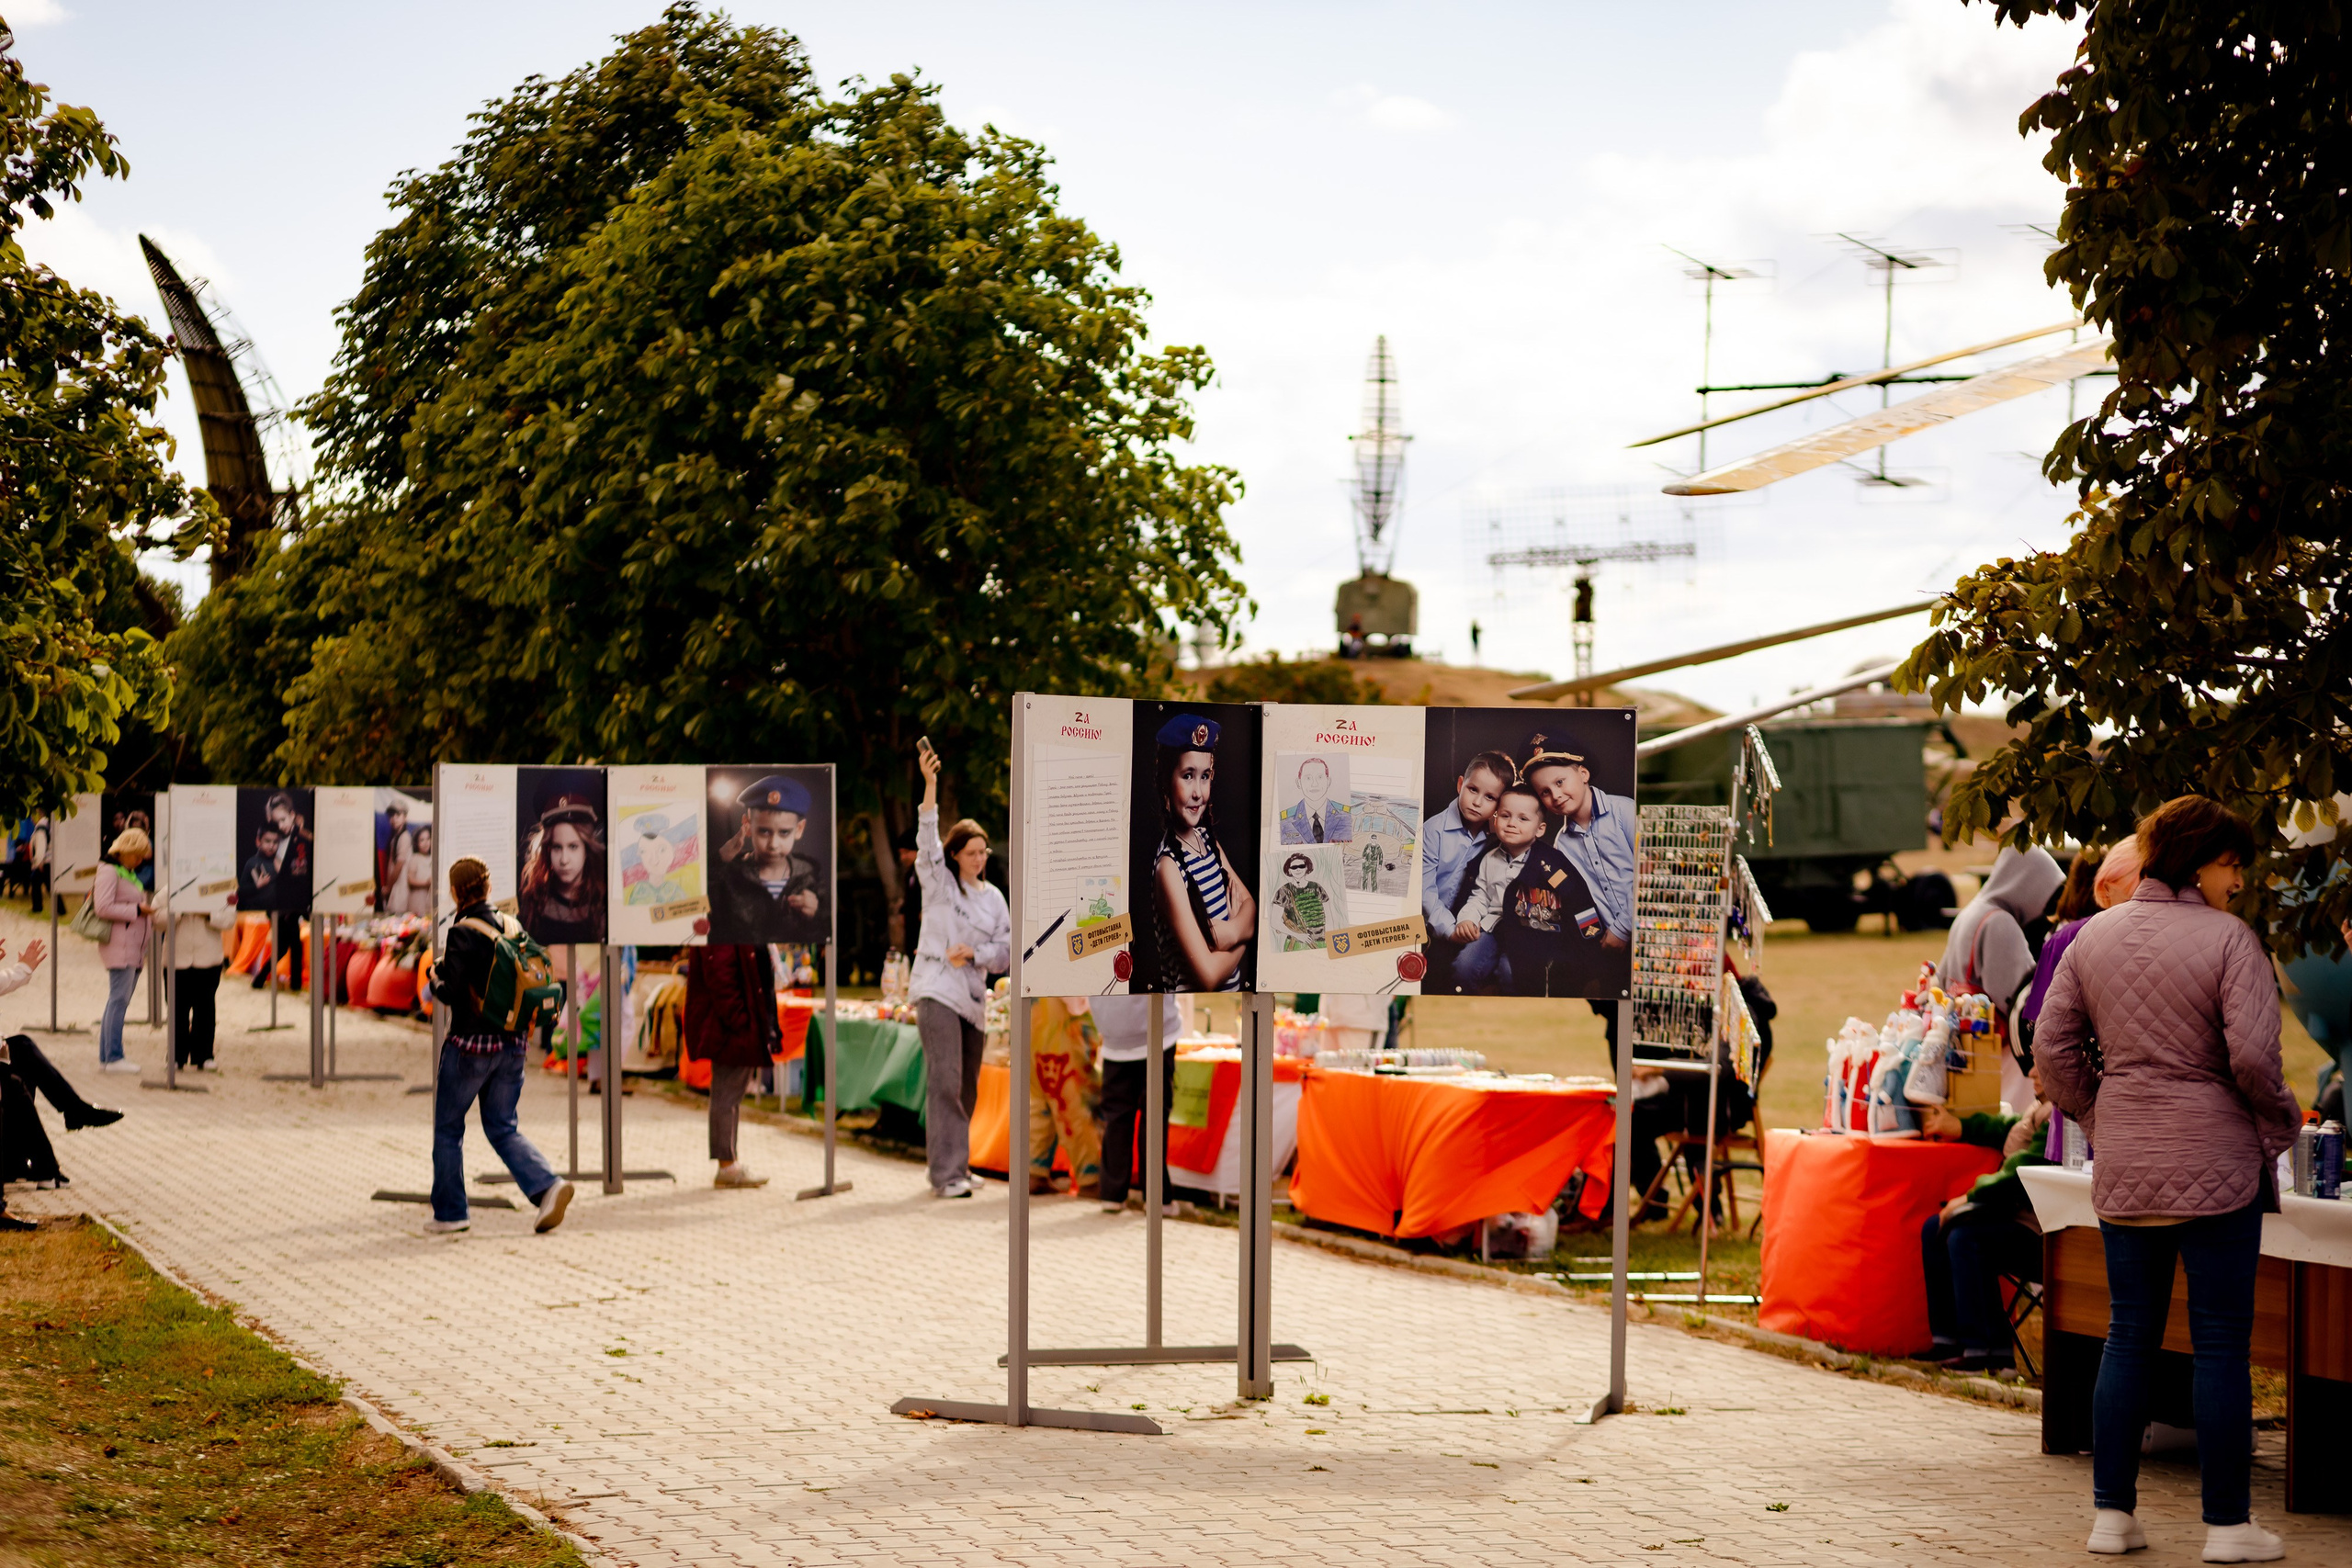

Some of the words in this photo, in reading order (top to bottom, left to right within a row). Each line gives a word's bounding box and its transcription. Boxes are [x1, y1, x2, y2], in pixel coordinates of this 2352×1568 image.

[1335, 719, 1357, 731] ZА
[1061, 726, 1102, 740] РОССИЮ!
[1315, 733, 1375, 747] РОССИЮ!
[1087, 922, 1122, 939] ФОТОВЫСТАВКА
[1357, 923, 1410, 939] ФОТОВЫСТАВКА
